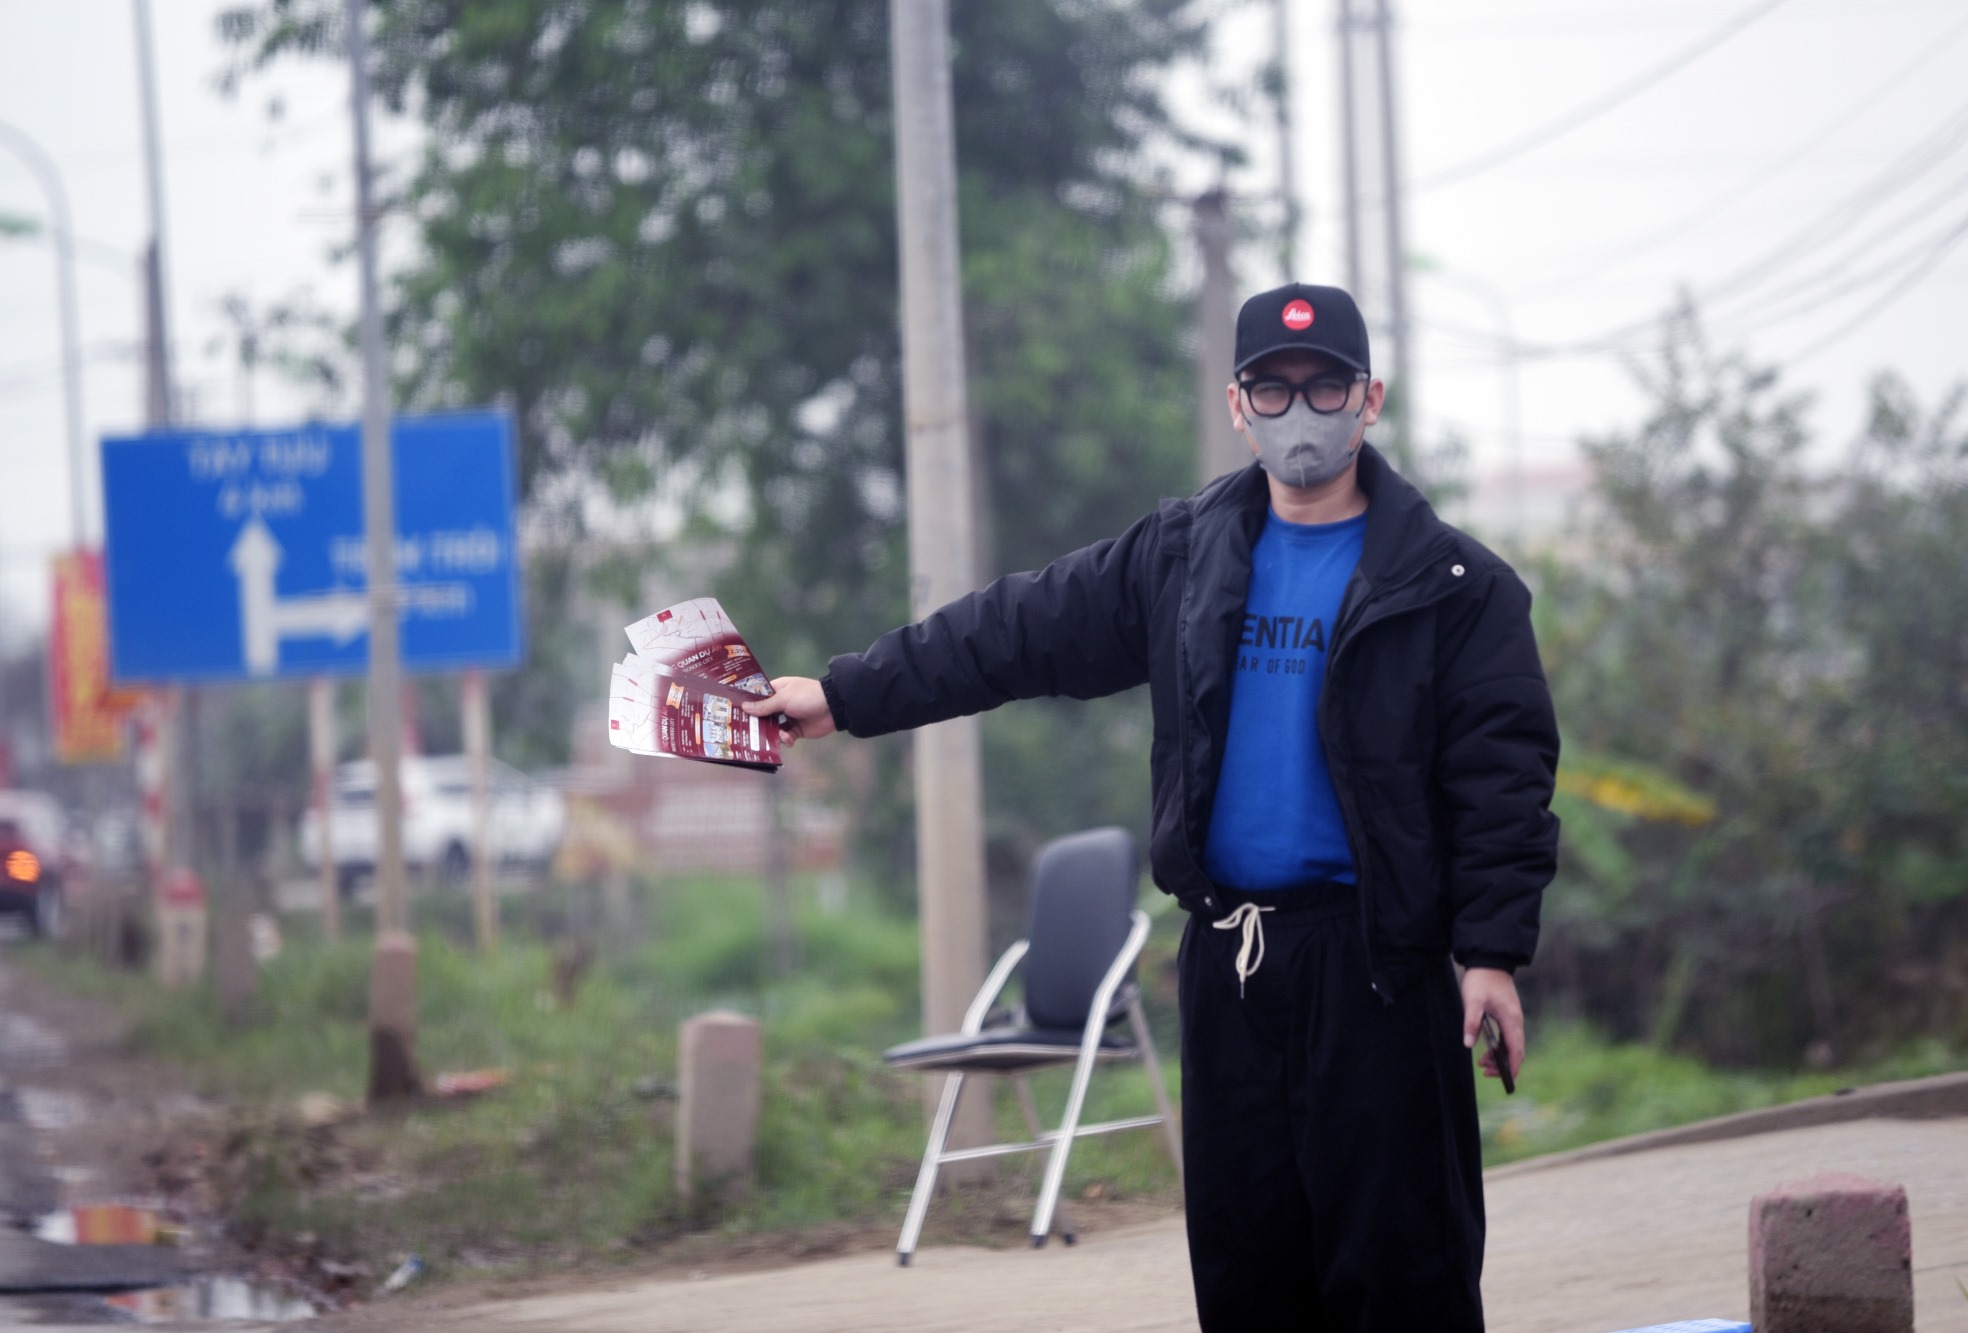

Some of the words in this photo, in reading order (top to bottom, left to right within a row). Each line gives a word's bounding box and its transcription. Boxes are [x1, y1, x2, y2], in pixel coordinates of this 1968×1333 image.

[677, 654, 699, 669] QUAN
[1267, 658, 1280, 674] OF
[1285, 658, 1306, 675] GOD
